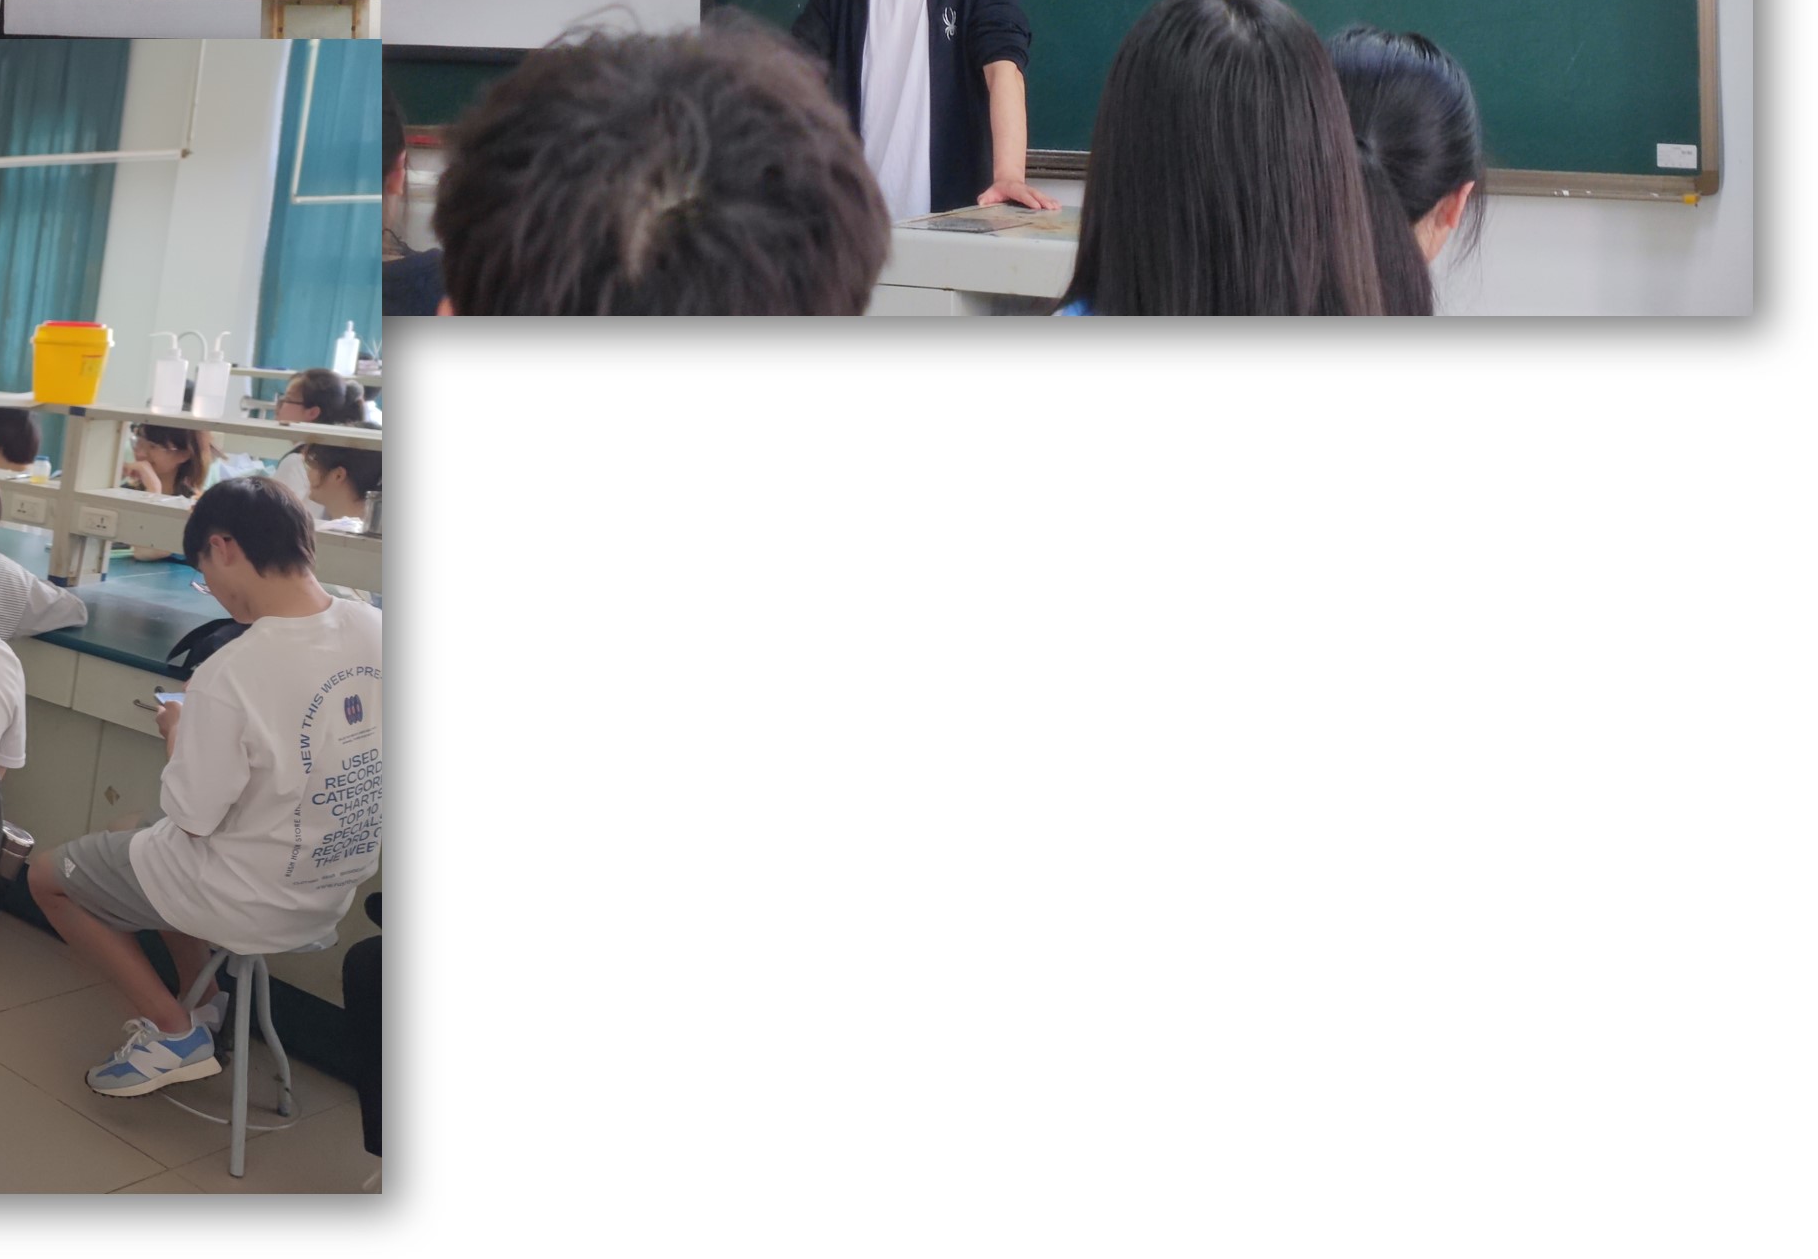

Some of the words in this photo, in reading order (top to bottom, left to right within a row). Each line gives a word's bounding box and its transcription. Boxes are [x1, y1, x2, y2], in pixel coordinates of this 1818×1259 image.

[321, 668, 354, 694] WEEK
[301, 694, 324, 728] THIS
[300, 733, 313, 774] NEW
[342, 748, 379, 771] USED
[338, 808, 364, 828] TOP
[367, 803, 379, 819] 10
[311, 829, 370, 858] RECORD
[314, 851, 340, 868] THE
